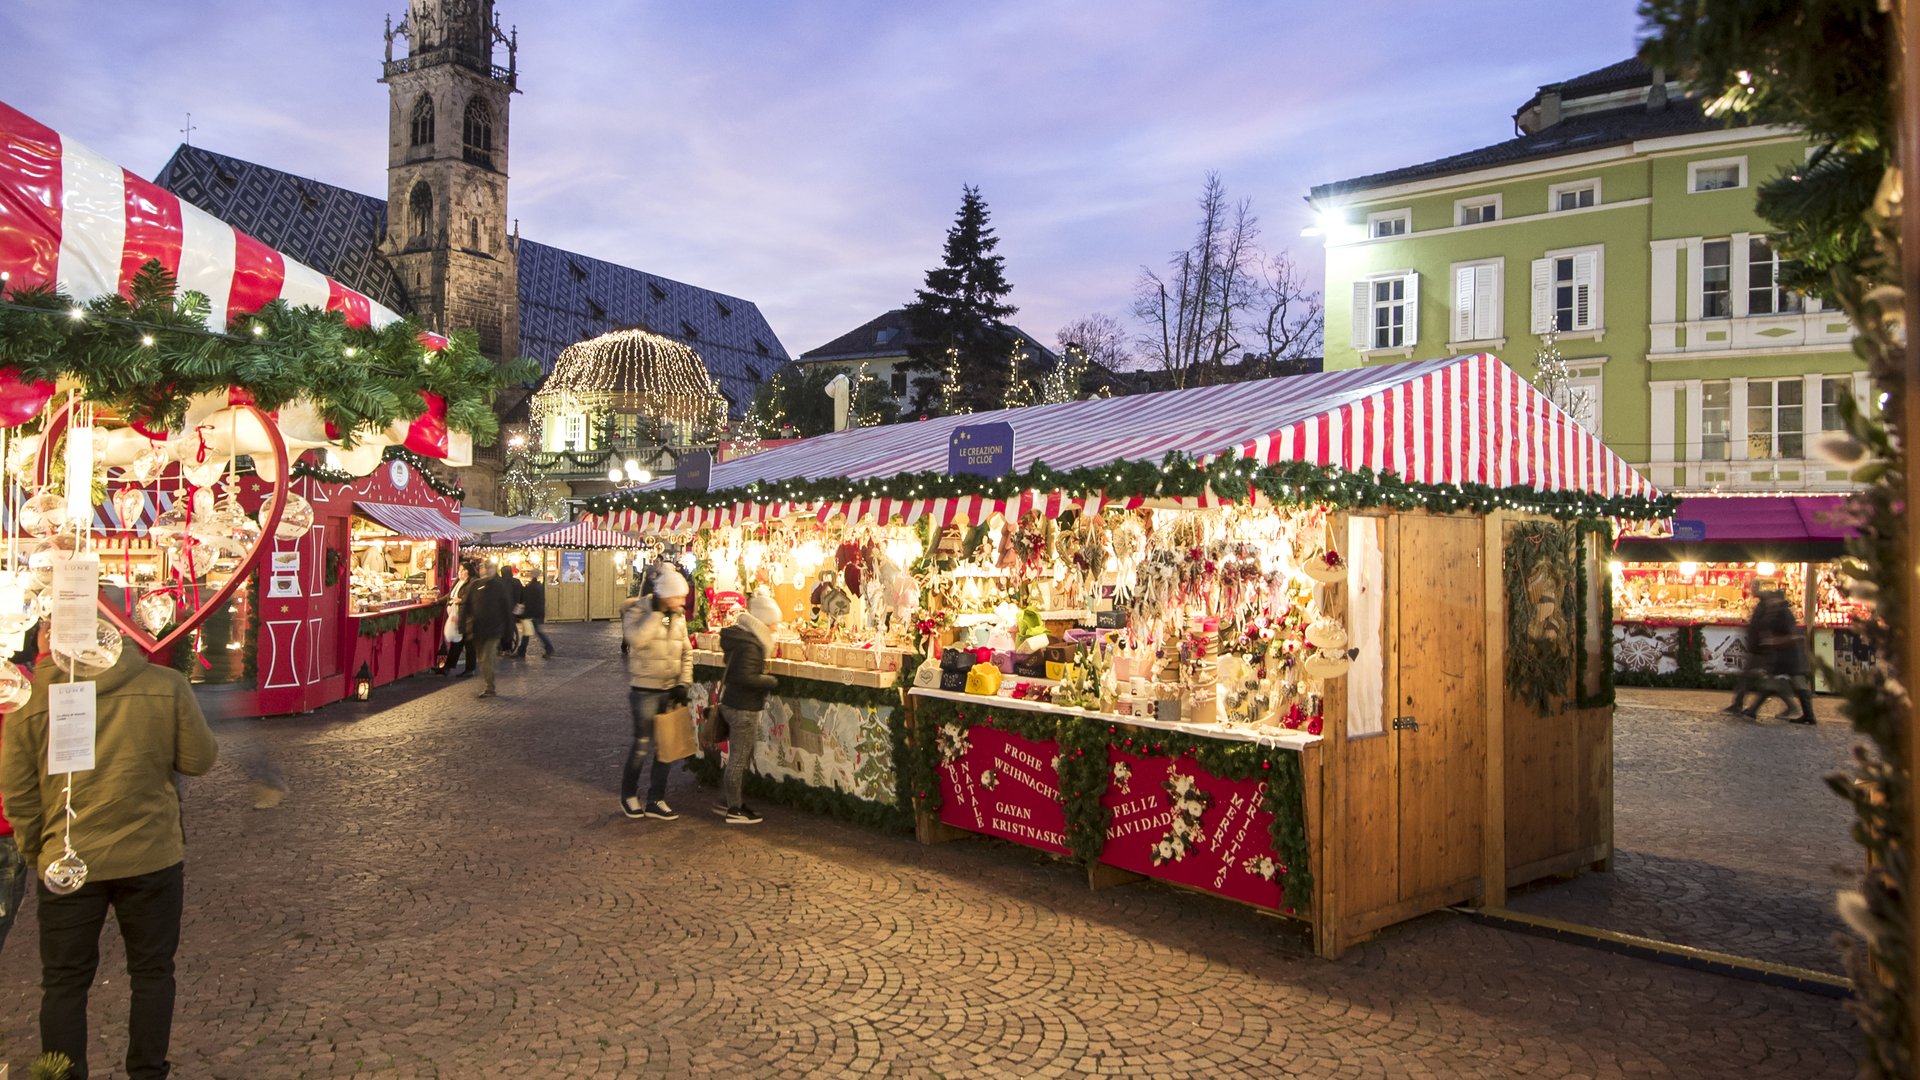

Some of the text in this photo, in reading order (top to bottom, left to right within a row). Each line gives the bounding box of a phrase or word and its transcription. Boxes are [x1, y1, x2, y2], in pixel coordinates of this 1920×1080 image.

[960, 445, 1003, 456] LE CREAZIONI
[968, 455, 993, 464] DI CLOE
[1004, 743, 1043, 772] FROHE
[948, 764, 965, 805] BUON
[961, 761, 984, 829] NATALE
[995, 801, 1032, 820] GAYAN
[1113, 795, 1158, 818] FELIZ
[1106, 812, 1172, 840] NAVIDAD
[1210, 792, 1244, 853] MERRY
[1214, 782, 1268, 889] CHRISTMAS
